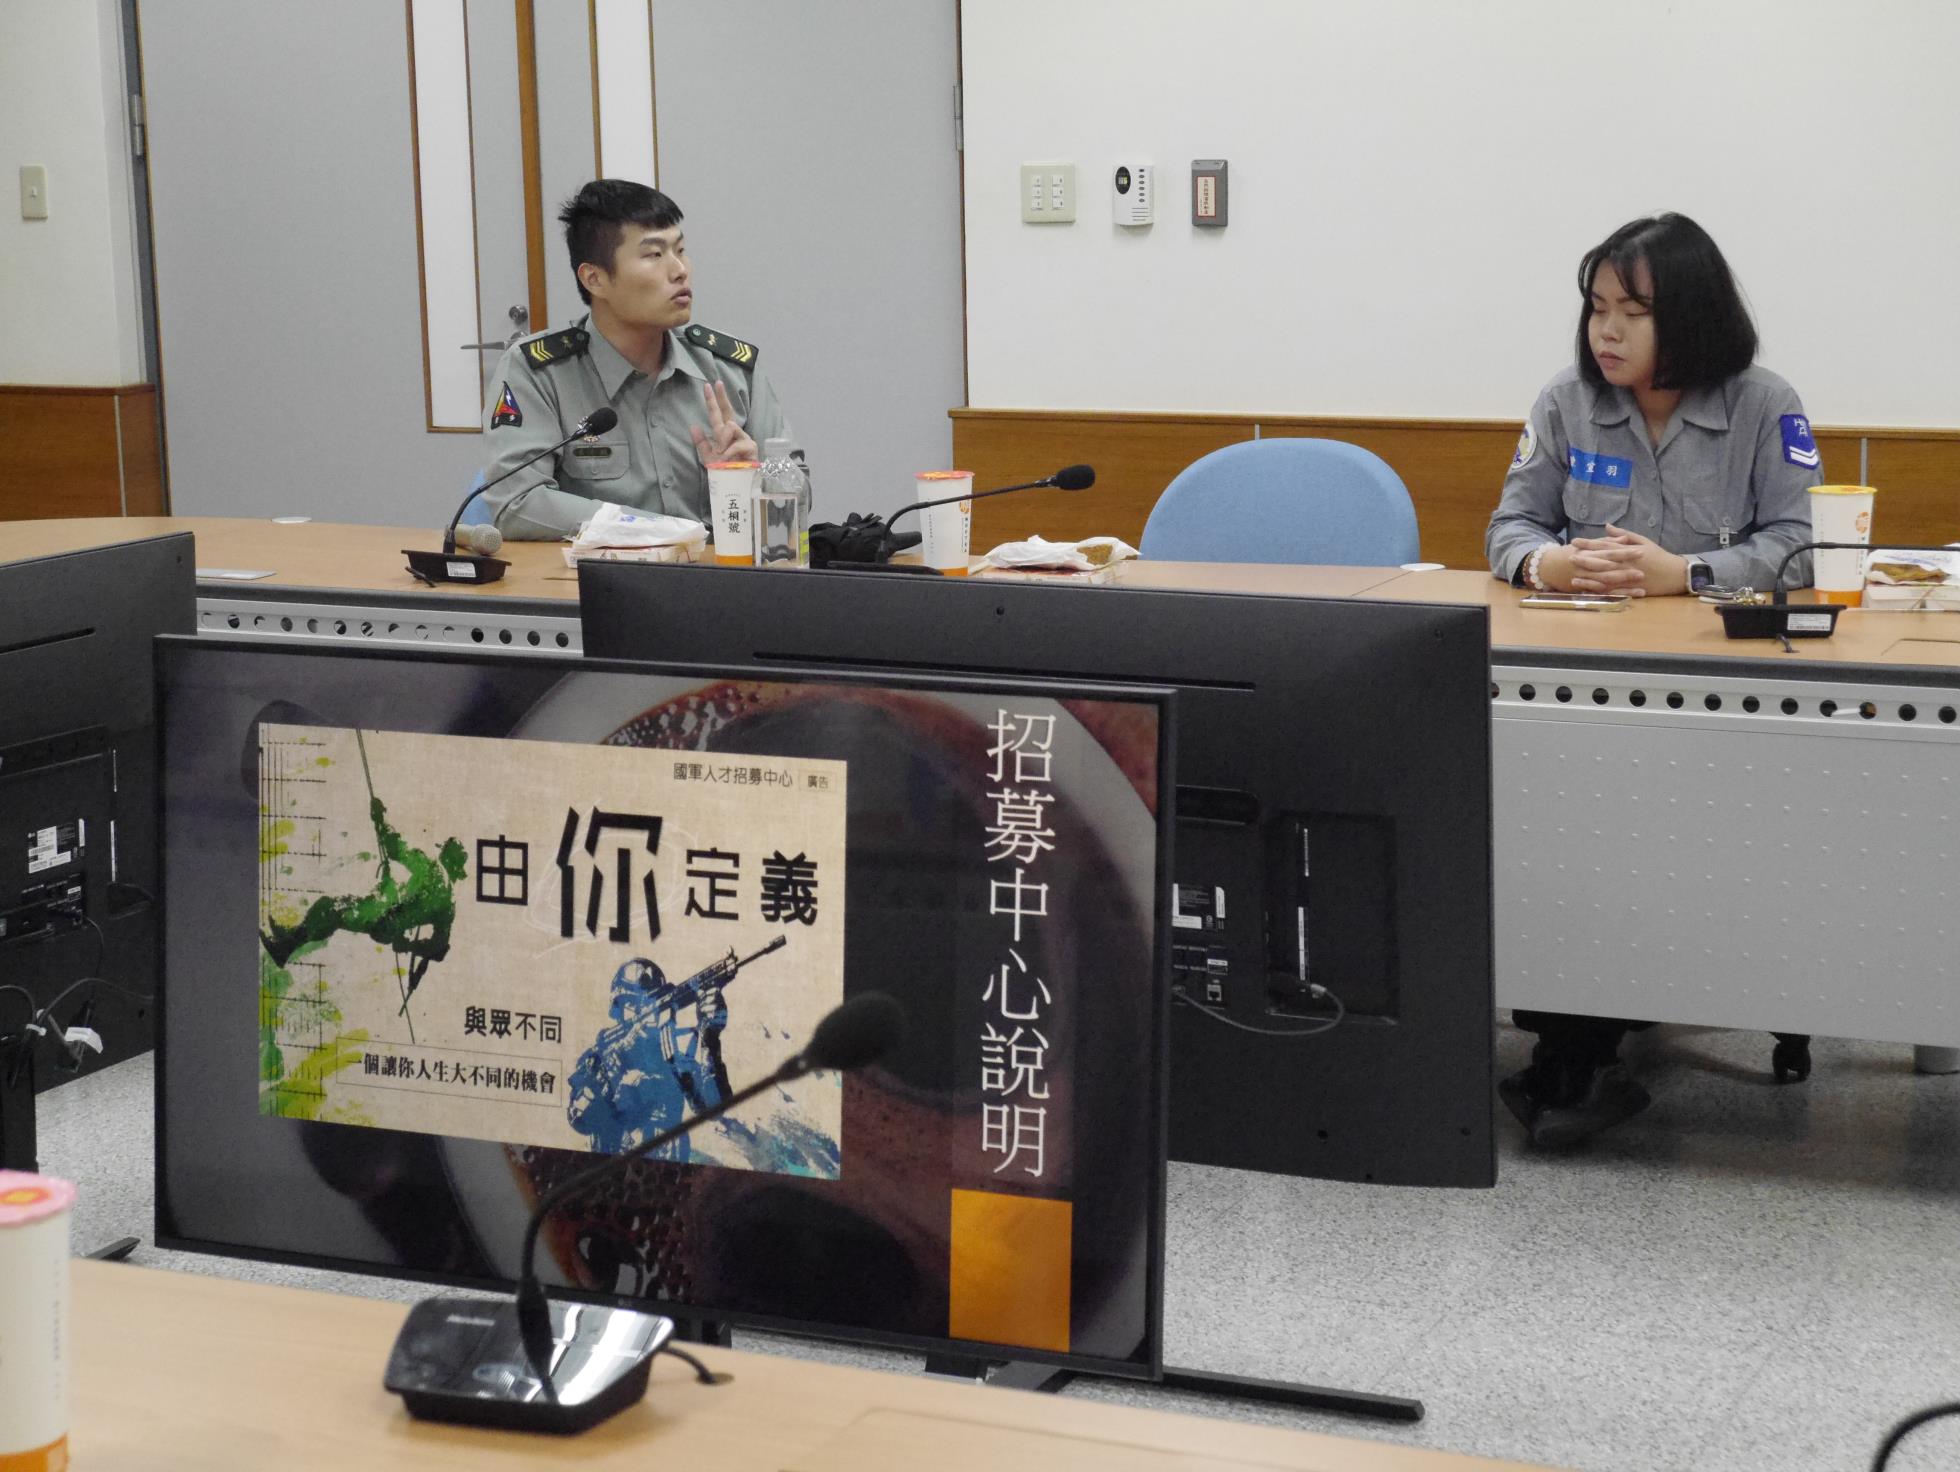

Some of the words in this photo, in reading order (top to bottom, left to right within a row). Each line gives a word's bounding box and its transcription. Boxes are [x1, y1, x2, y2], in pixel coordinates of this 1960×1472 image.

[728, 499, 740, 533] 五桐號
[674, 763, 792, 787] 國軍人才招募中心
[808, 776, 828, 788] 廣告
[476, 806, 818, 942] 由你定義
[982, 708, 1057, 1177] 招募中心說明
[465, 1006, 562, 1043] 與眾不同
[347, 1053, 555, 1093] 一個讓你人生大不同的機會
